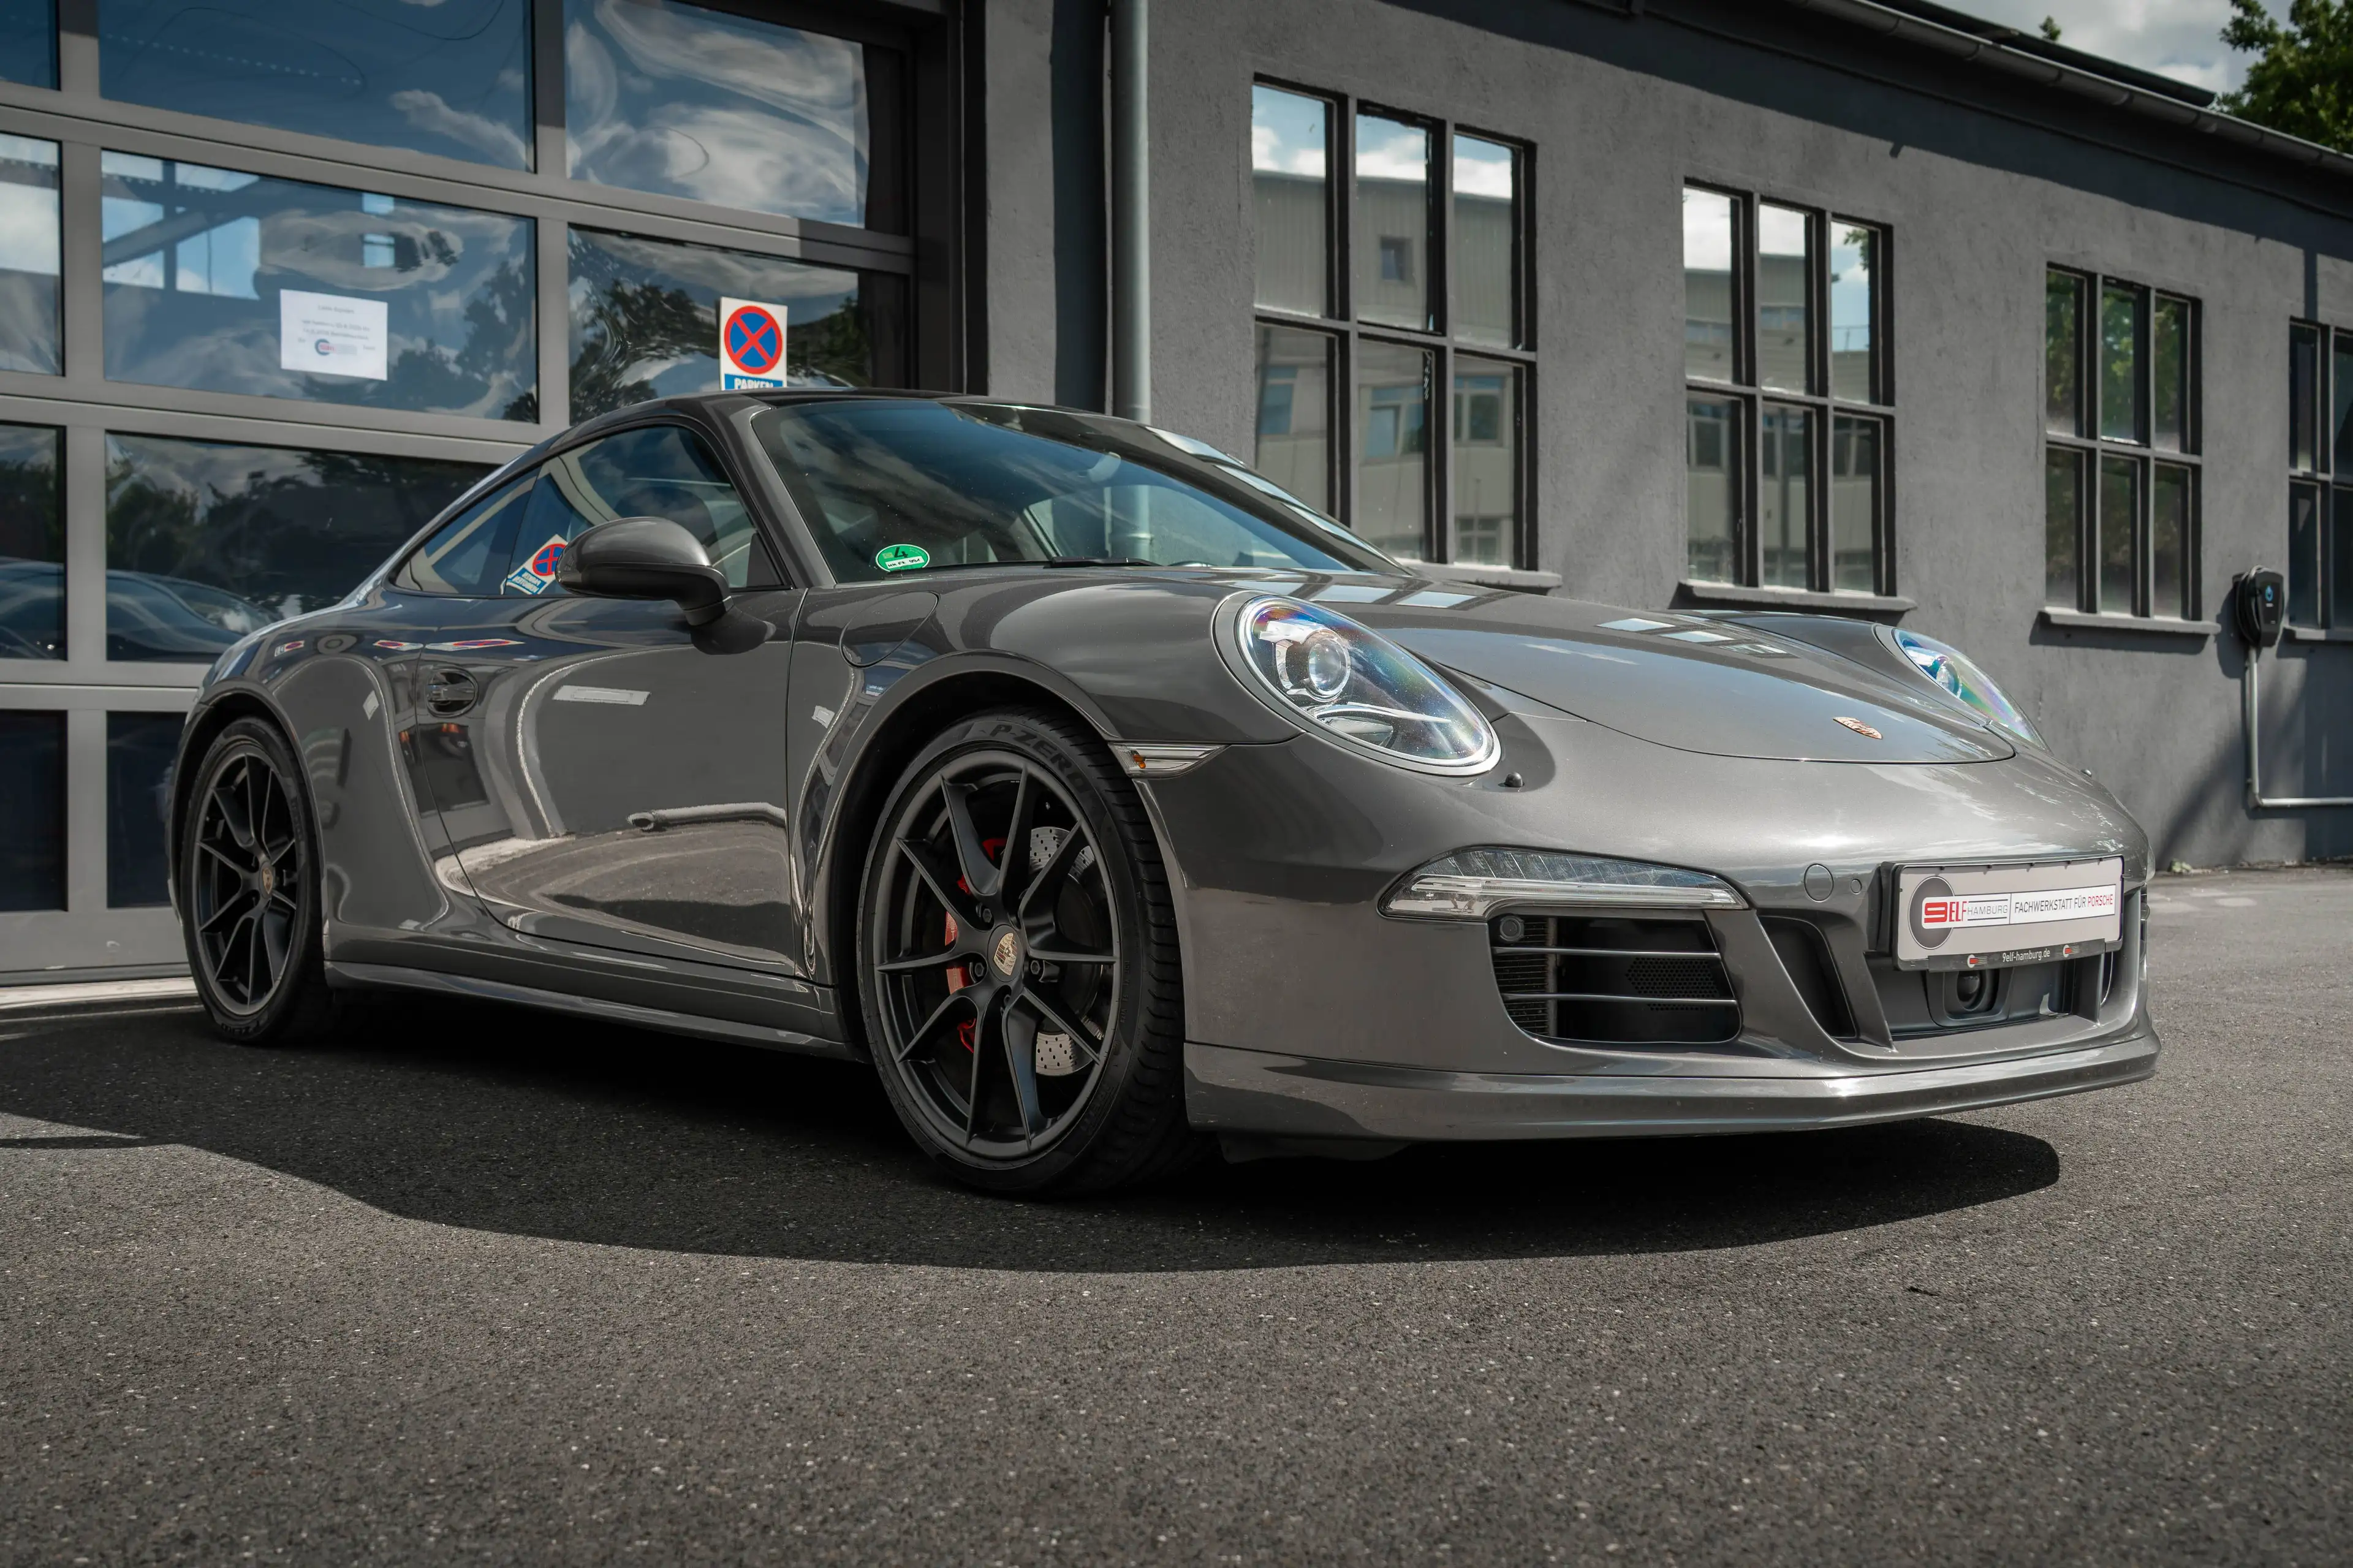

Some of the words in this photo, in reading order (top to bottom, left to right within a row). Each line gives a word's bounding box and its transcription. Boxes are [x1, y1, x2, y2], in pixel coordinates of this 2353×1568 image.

[1967, 904, 2009, 915] HAMBURG
[2014, 898, 2072, 914] FACHWERKSTATT
[2074, 895, 2086, 909] FÜR
[2088, 894, 2113, 907] PORSCHE
[2002, 948, 2051, 963] 9elf-hamburg.de
